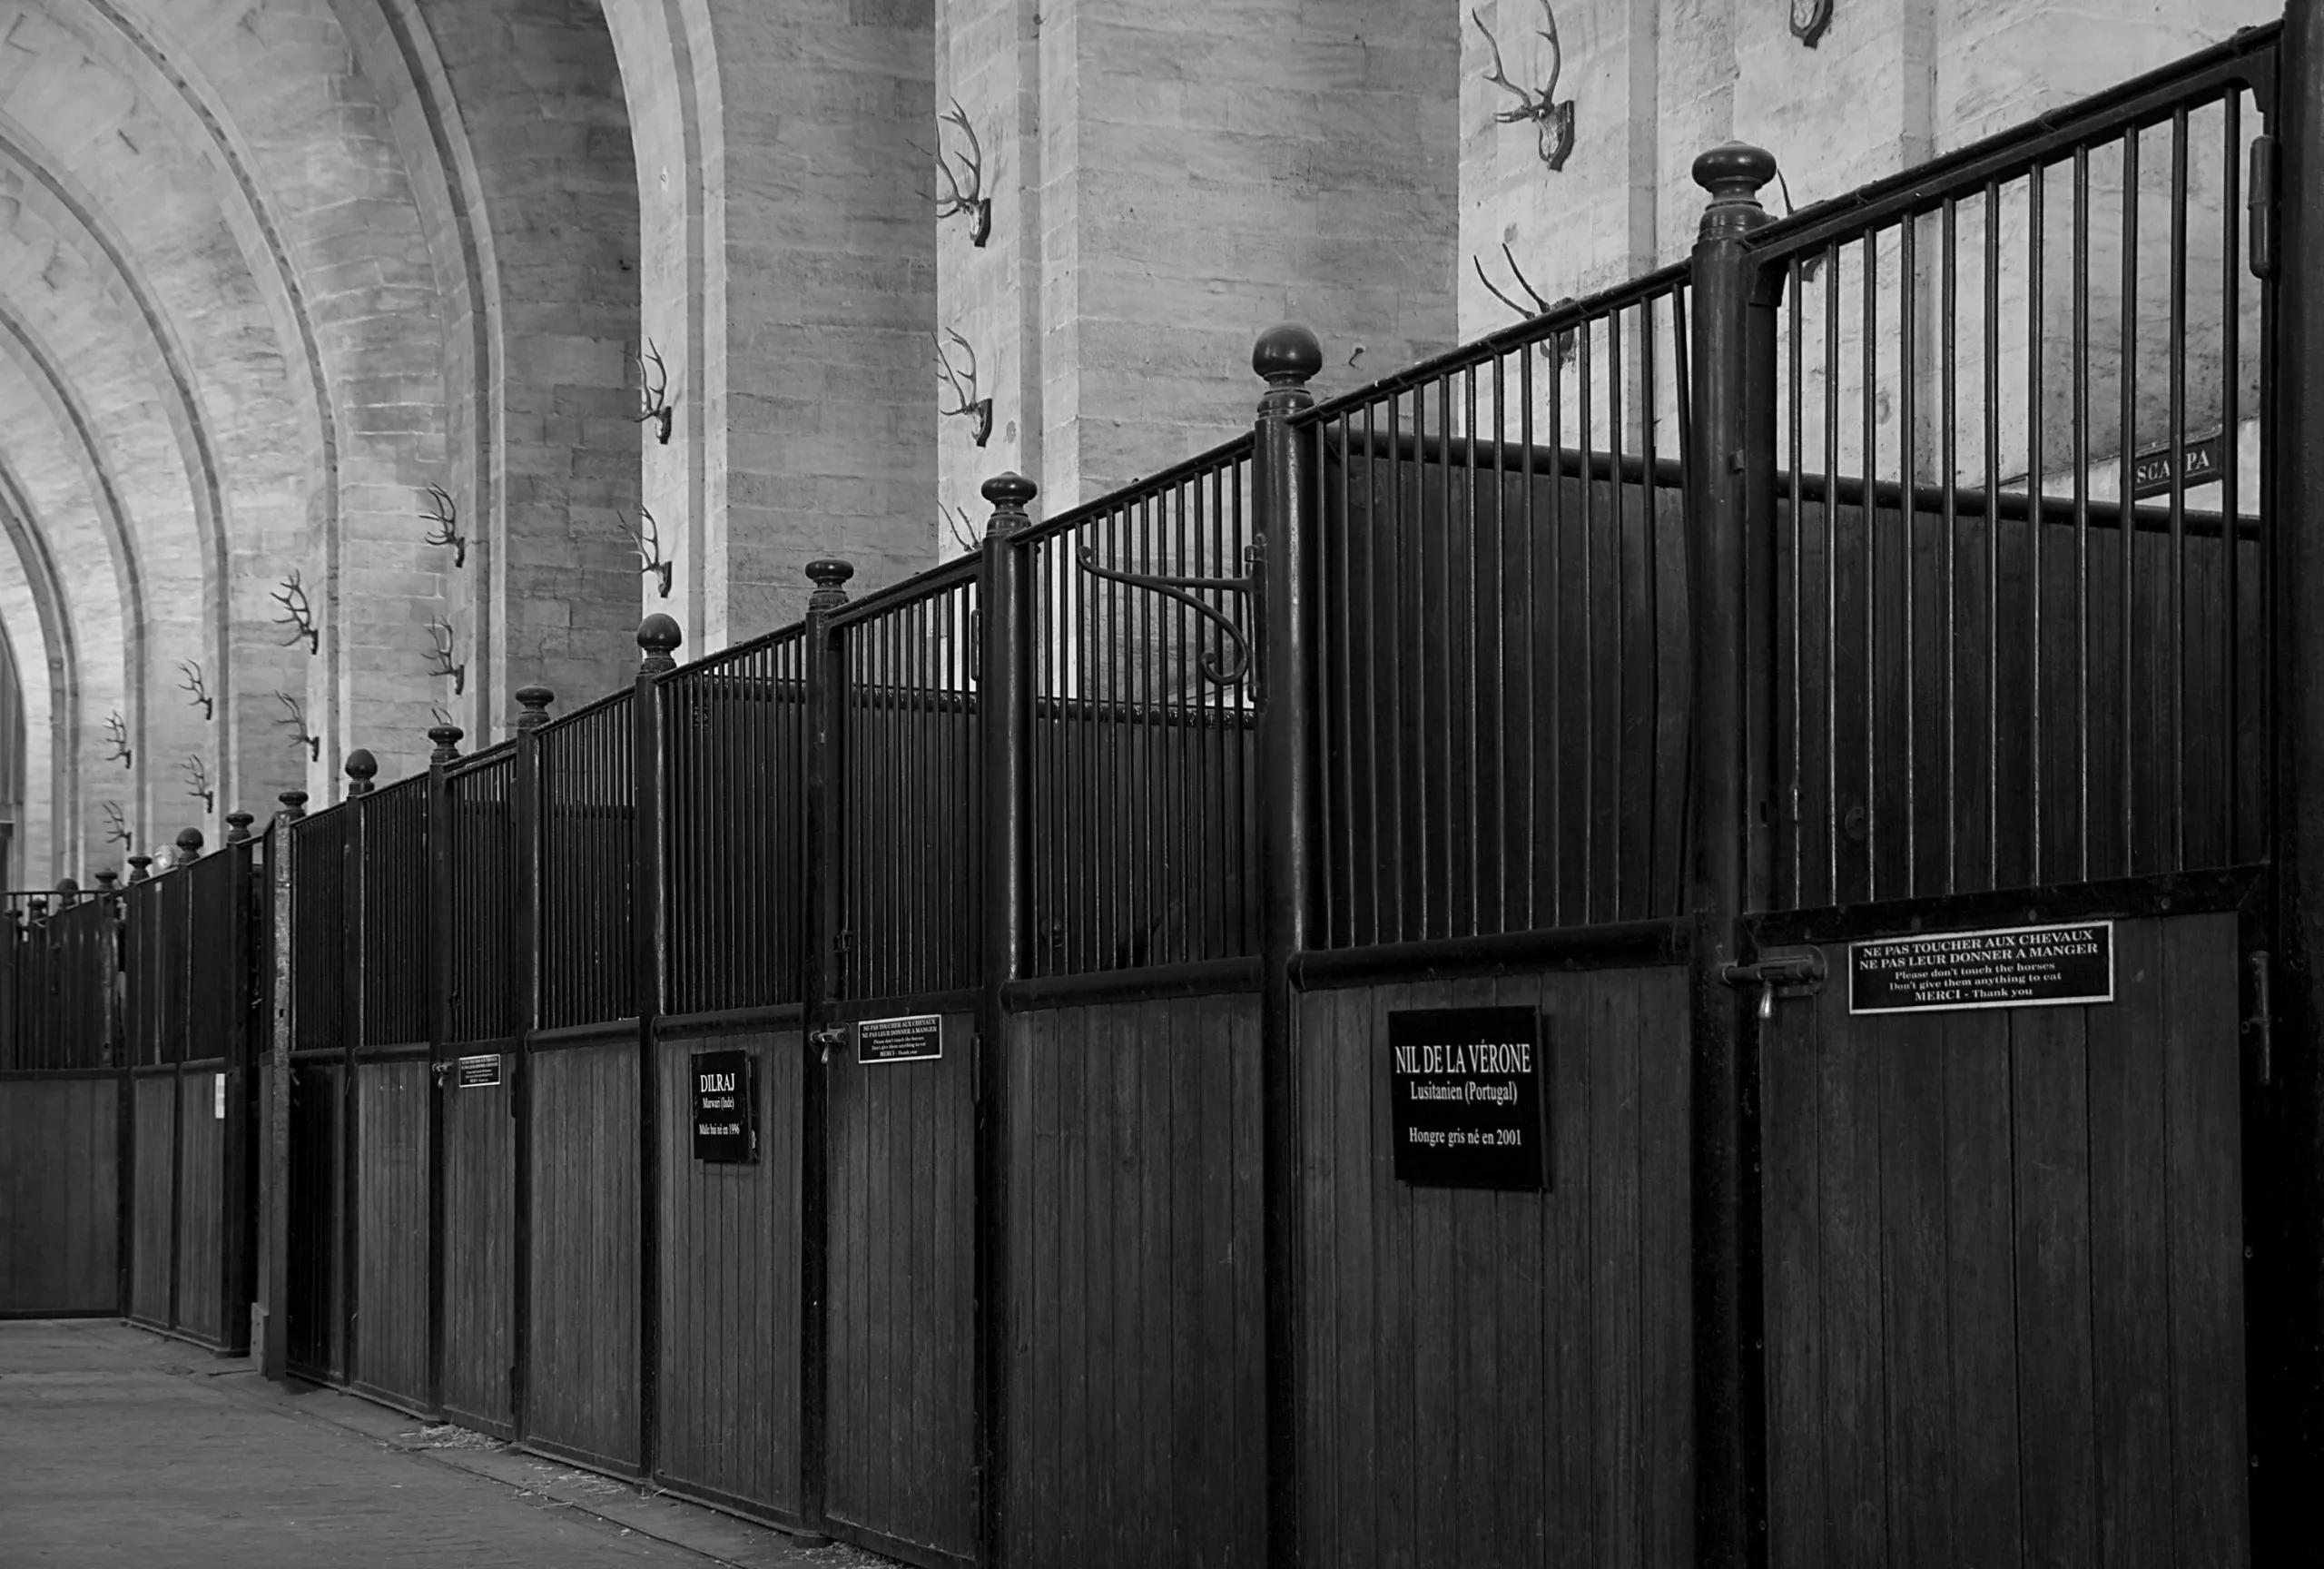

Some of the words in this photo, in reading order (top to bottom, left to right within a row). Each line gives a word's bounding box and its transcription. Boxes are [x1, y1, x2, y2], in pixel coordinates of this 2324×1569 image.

[2137, 449, 2210, 483] SCAPA
[1864, 947, 1882, 958] NE
[1885, 944, 1909, 955] PAS
[1912, 939, 1981, 954] TOUCHER
[1984, 936, 2015, 947] AUX
[2019, 930, 2093, 945] CHEVAUX
[1859, 959, 1877, 970] NE
[1881, 957, 1905, 968] PAS
[1908, 954, 1946, 966] LEUR
[1950, 949, 2012, 963] DONNER
[2029, 943, 2098, 958] MANGER
[1895, 970, 1928, 981] Please
[1930, 967, 1958, 978] don't
[1961, 965, 1992, 974] touch
[1995, 963, 2014, 973] the
[2017, 962, 2055, 972] horses
[1889, 982, 1916, 991] Don't
[1919, 980, 1941, 991] give
[1944, 977, 1972, 987] them
[1974, 974, 2025, 987] anything
[2028, 973, 2040, 982] to
[2043, 972, 2062, 981] eat
[1915, 991, 1960, 1002] MERCI
[1972, 989, 2008, 998] Thank
[2011, 988, 2033, 996] you
[1395, 1046, 1420, 1073] NIL
[1423, 1045, 1443, 1072] DE
[1446, 1045, 1466, 1072] LA
[1469, 1039, 1531, 1072] VÉRONE
[700, 1073, 734, 1092] DILRAJ
[1411, 1081, 1462, 1100] Lusitanien
[1465, 1081, 1518, 1105] (Portugal)
[703, 1097, 720, 1109] Marwari
[721, 1097, 734, 1110] (Inde)
[729, 1124, 740, 1135] 1996
[1409, 1127, 1445, 1147] Hongre
[1448, 1128, 1465, 1147] gris
[1468, 1129, 1479, 1144] né
[1482, 1133, 1493, 1144] en
[1497, 1130, 1521, 1145] 2001
